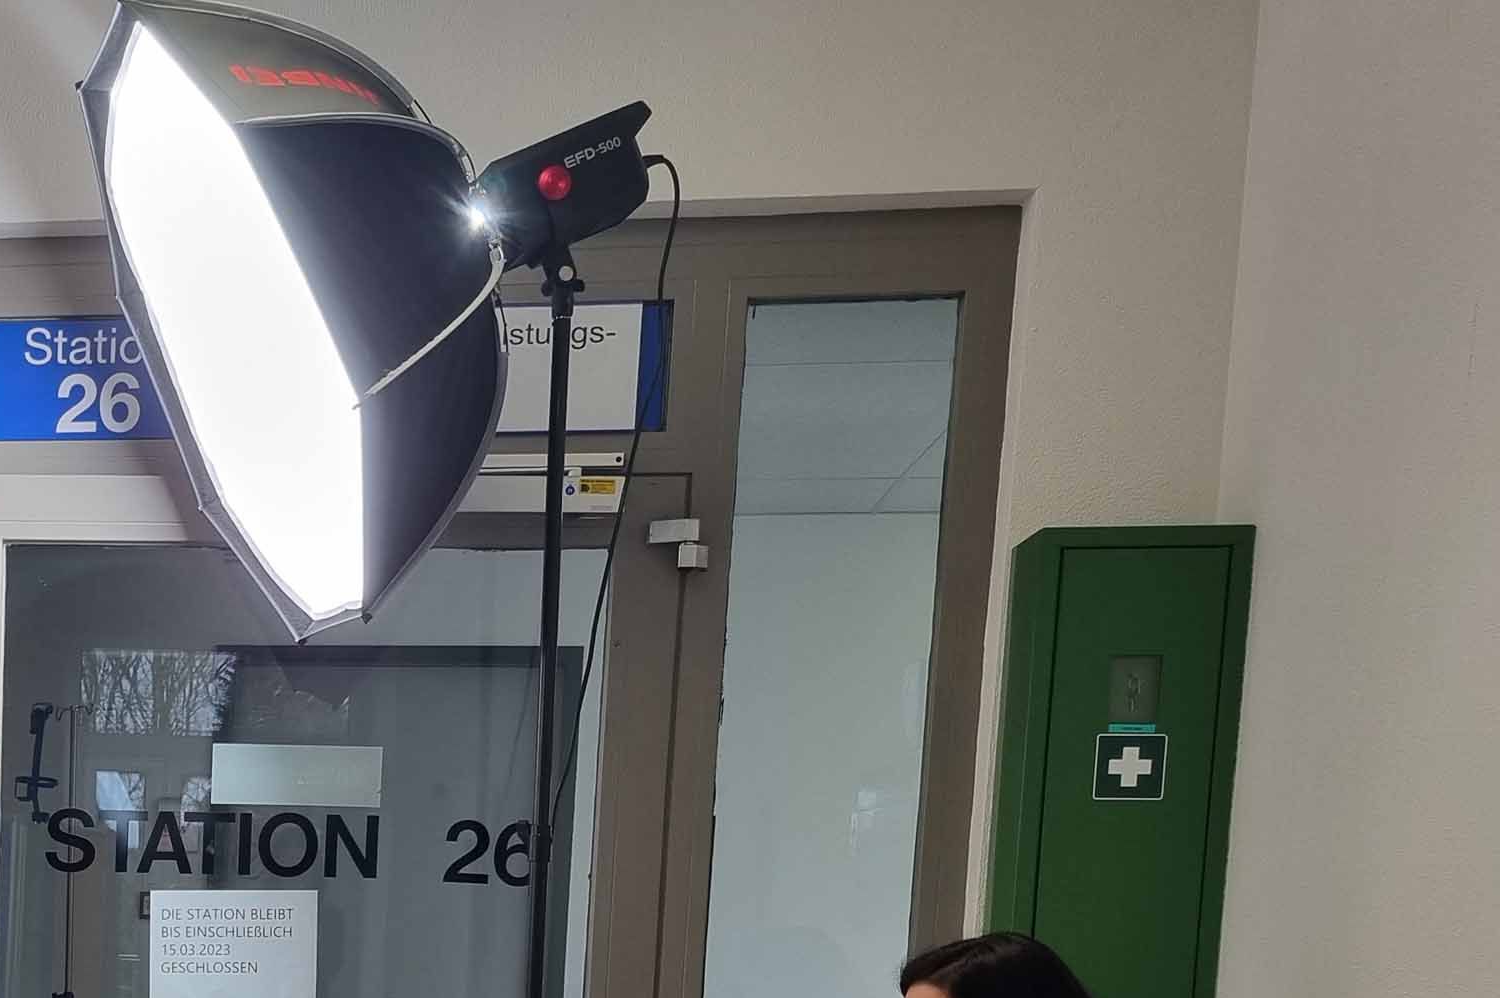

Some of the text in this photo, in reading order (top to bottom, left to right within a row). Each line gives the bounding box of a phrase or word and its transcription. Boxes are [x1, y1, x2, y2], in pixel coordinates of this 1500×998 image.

[564, 136, 621, 169] EFD-500
[56, 372, 141, 433] 26
[45, 807, 531, 887] STATION 26
[161, 907, 295, 921] DIE STATION BLEIBT
[161, 926, 293, 938] BIS EINSCHLIEßLICH
[162, 943, 231, 956] 15.03.2023
[160, 961, 259, 974] GESCHLOSSEN
